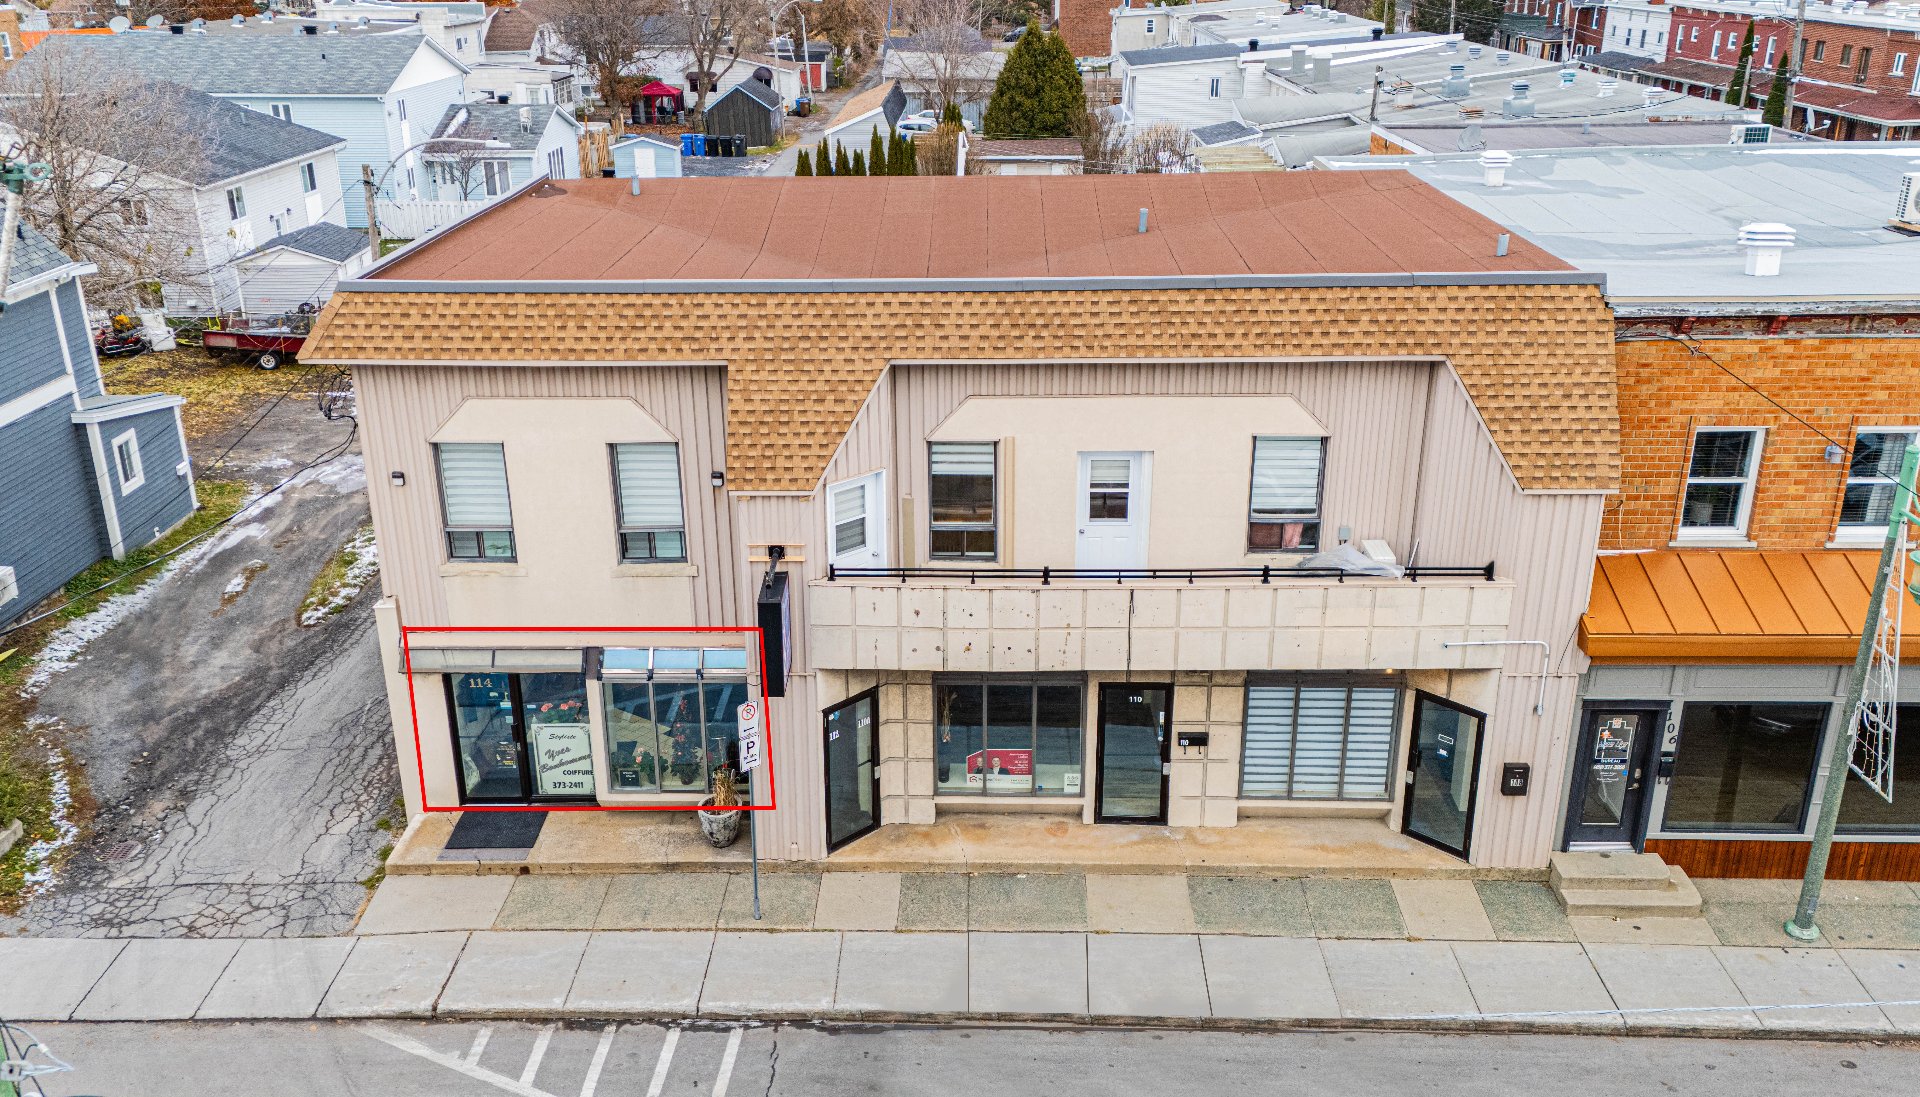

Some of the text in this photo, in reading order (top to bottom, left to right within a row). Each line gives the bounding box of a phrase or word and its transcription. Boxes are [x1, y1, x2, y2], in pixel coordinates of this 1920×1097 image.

[469, 678, 493, 688] 114
[746, 741, 756, 754] P
[552, 781, 584, 789] 373-2411
